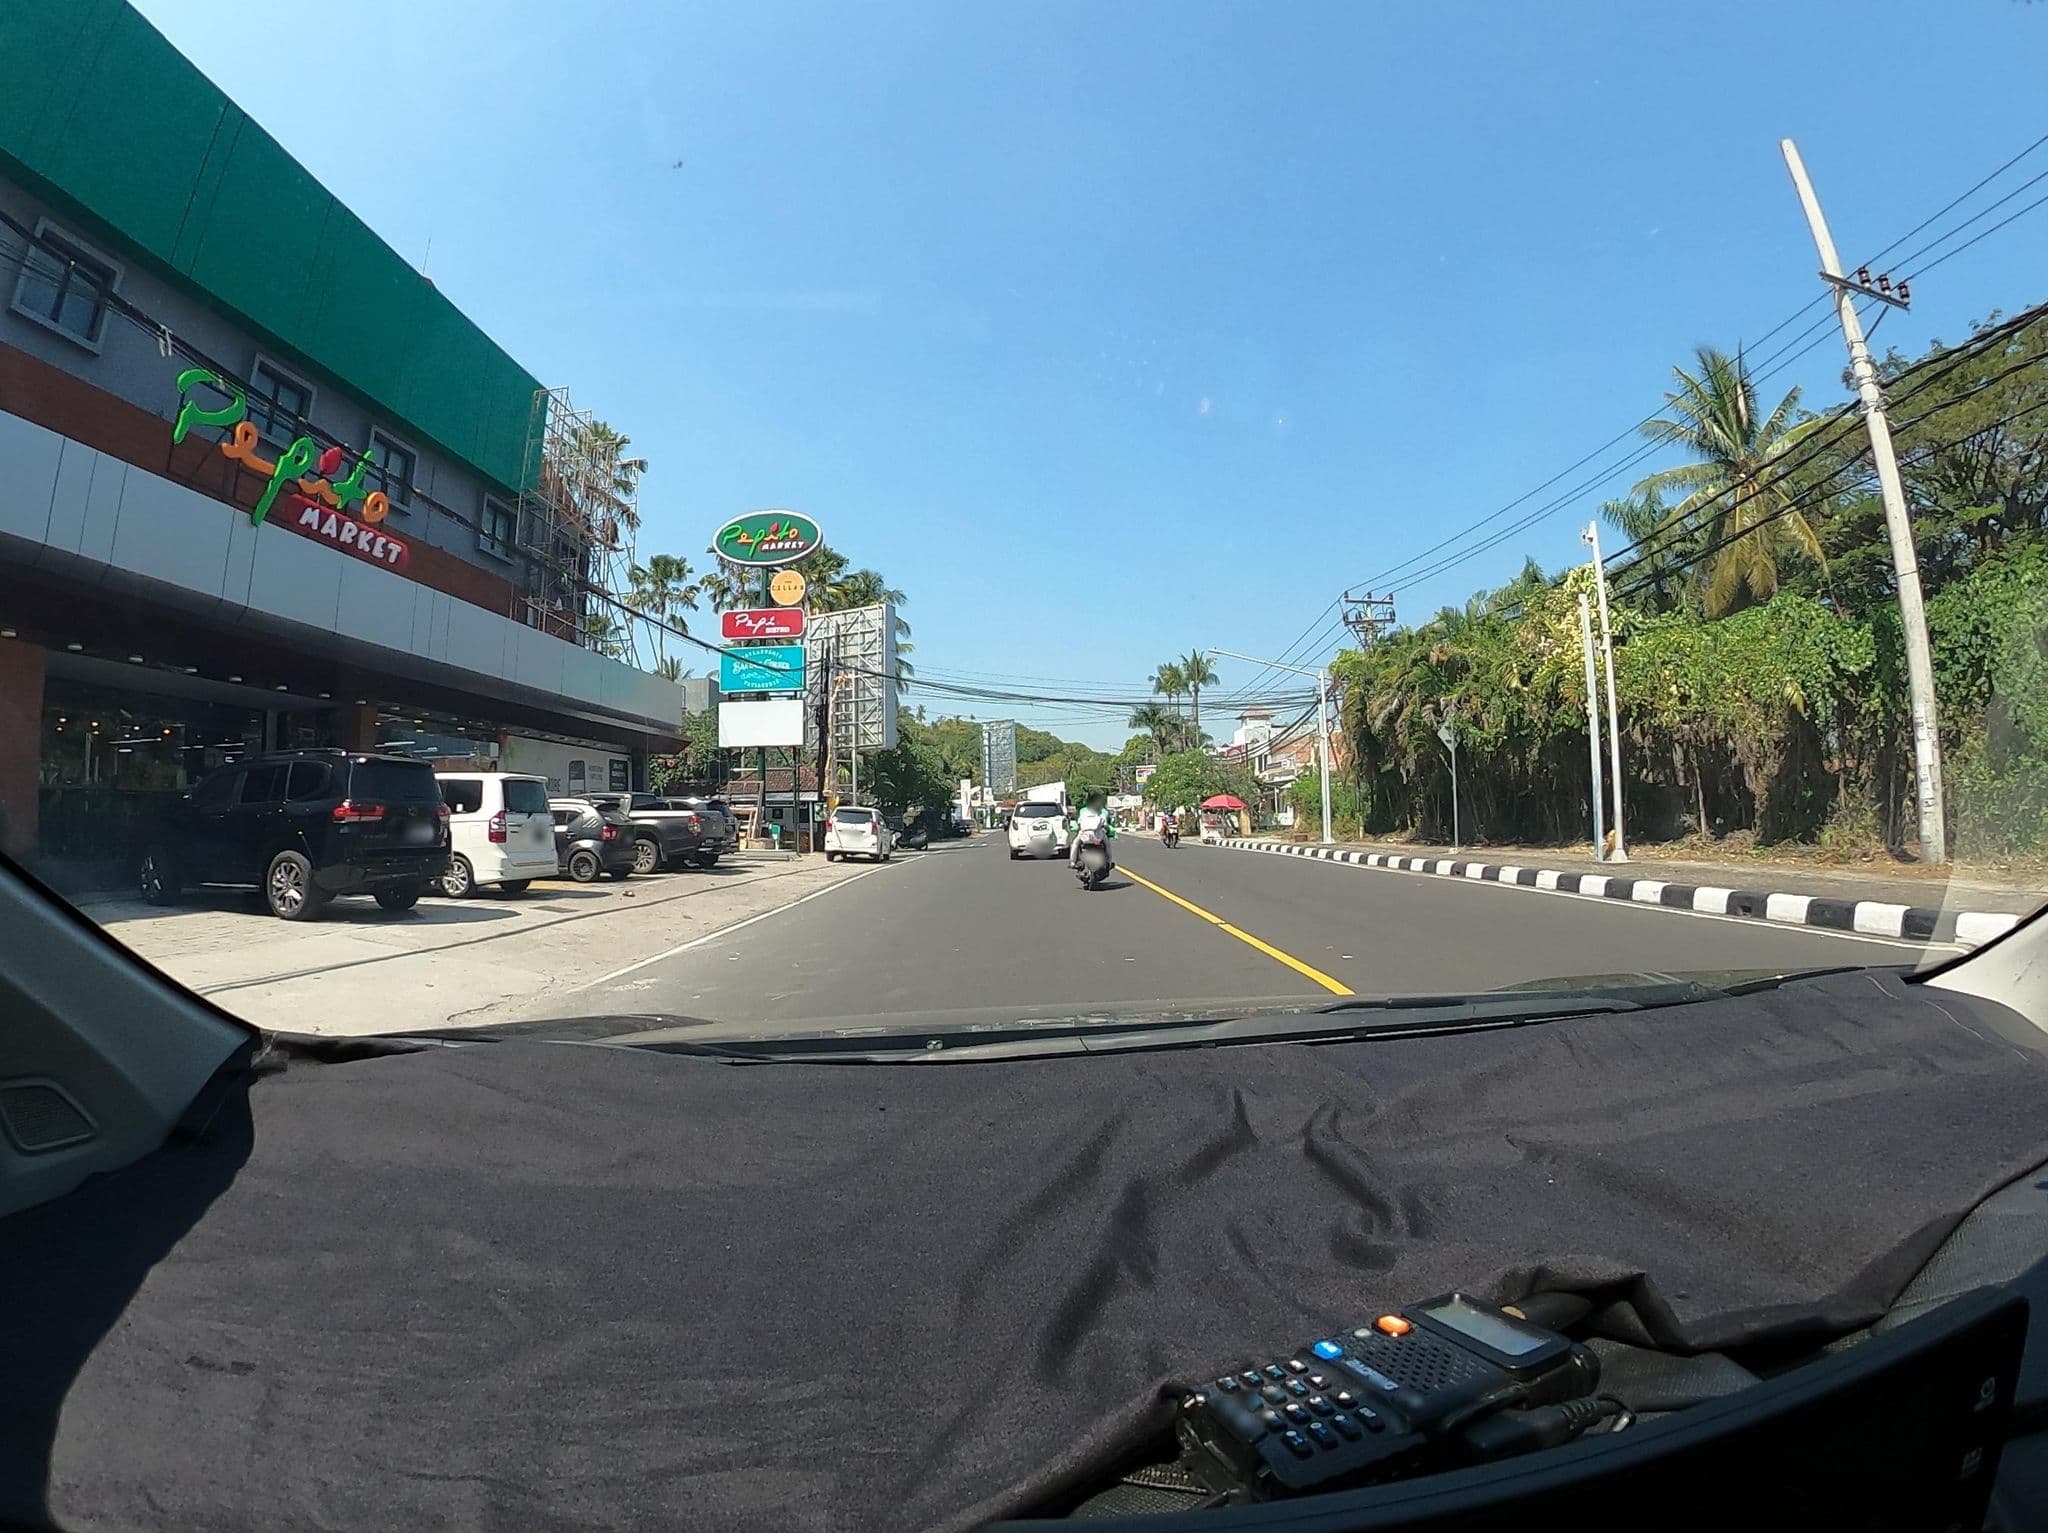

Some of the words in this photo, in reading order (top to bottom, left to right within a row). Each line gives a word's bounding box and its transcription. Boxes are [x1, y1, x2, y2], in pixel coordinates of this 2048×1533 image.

[173, 368, 390, 528] Pepito
[298, 506, 403, 565] MARKET
[722, 520, 799, 558] Pepito
[761, 541, 805, 551] MARKET
